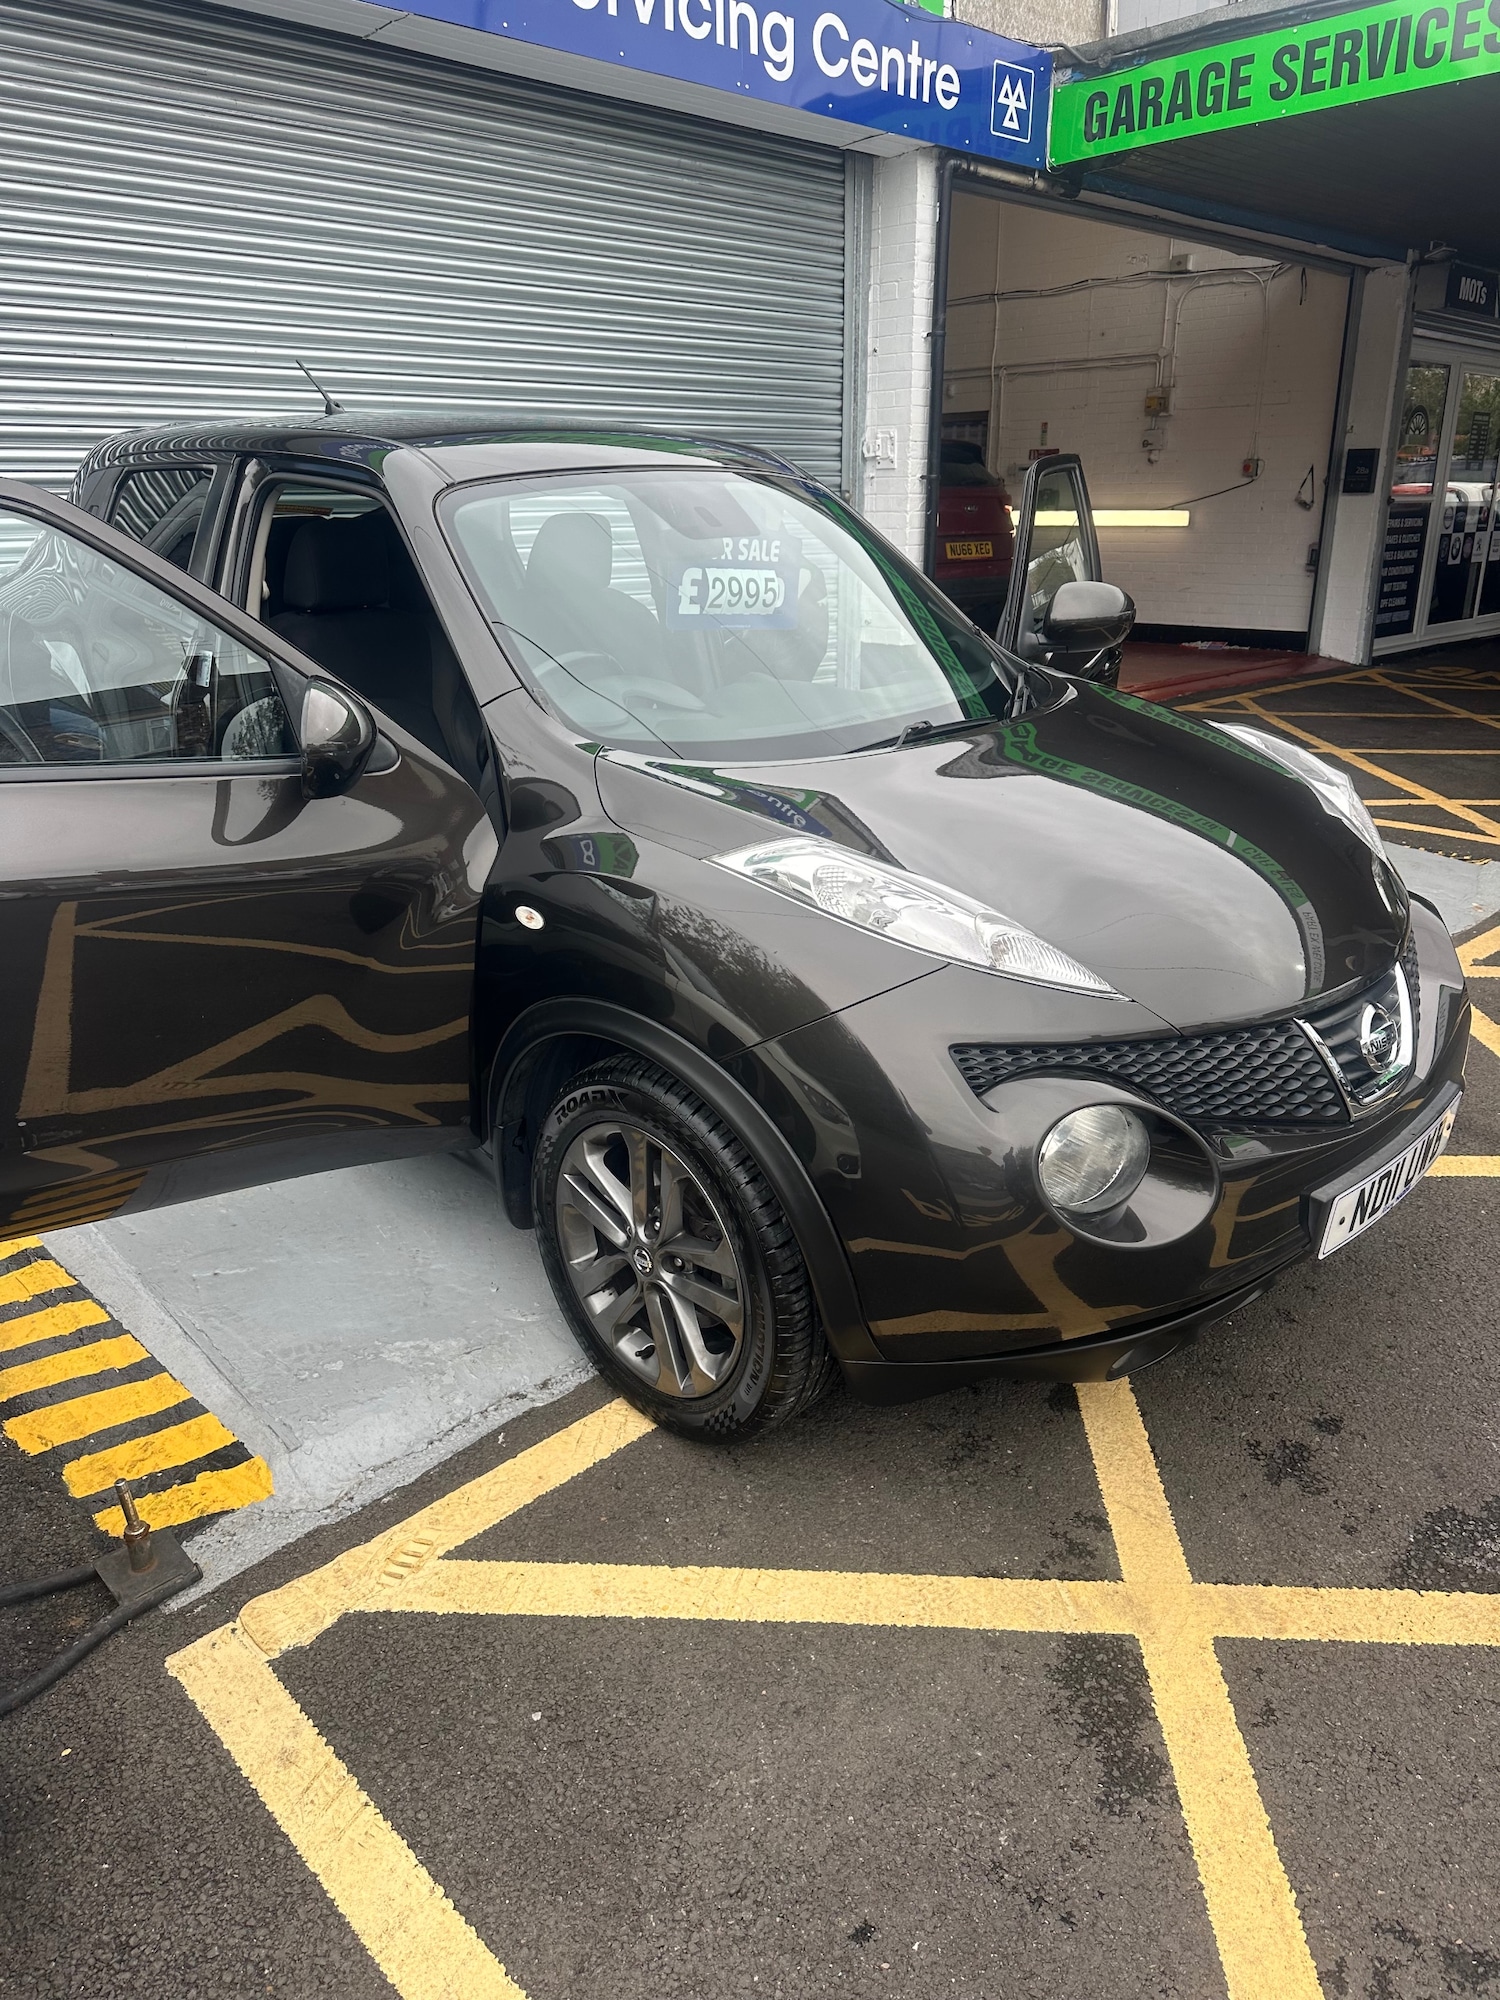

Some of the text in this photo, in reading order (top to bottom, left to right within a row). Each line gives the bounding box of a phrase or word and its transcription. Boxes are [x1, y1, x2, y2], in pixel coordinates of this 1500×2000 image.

[572, 0, 961, 110] vicing Centre
[1083, 53, 1256, 143] GARAGE
[1458, 276, 1488, 305] MOTs
[738, 538, 781, 562] SALE
[949, 542, 991, 556] NU66 XEG
